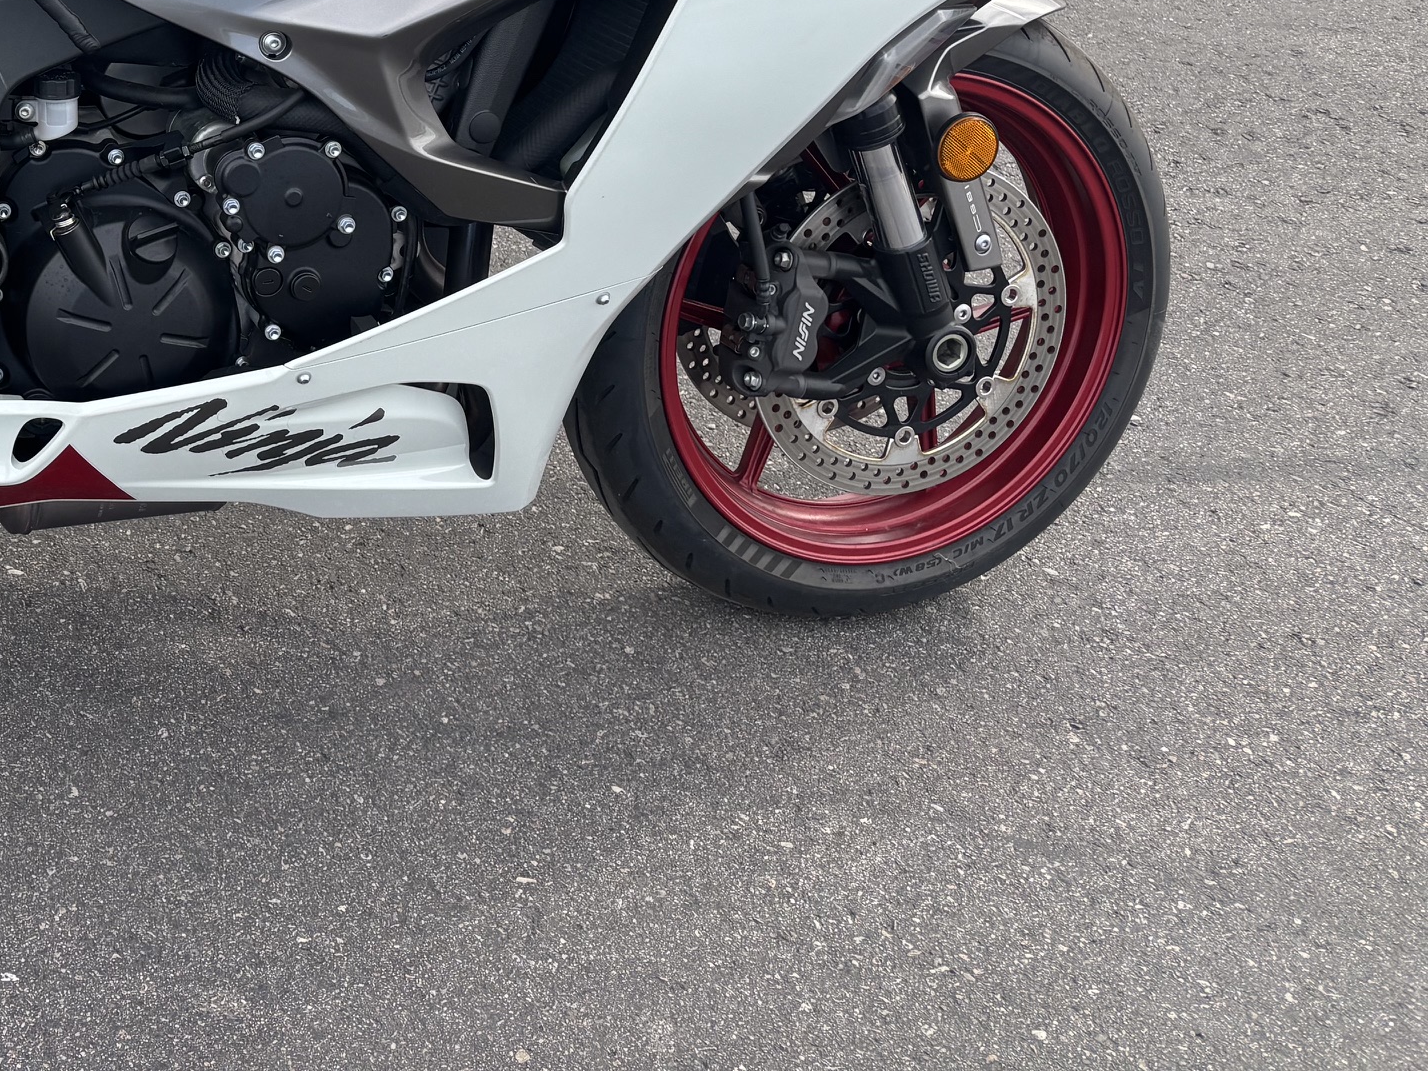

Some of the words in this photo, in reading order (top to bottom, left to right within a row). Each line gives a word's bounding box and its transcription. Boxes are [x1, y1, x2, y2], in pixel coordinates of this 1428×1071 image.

[1107, 158, 1145, 246] ROSSO
[917, 251, 943, 304] SHOWA
[792, 301, 816, 362] NISSIN
[112, 397, 401, 477] Ninja
[662, 447, 697, 508] PIRELLI
